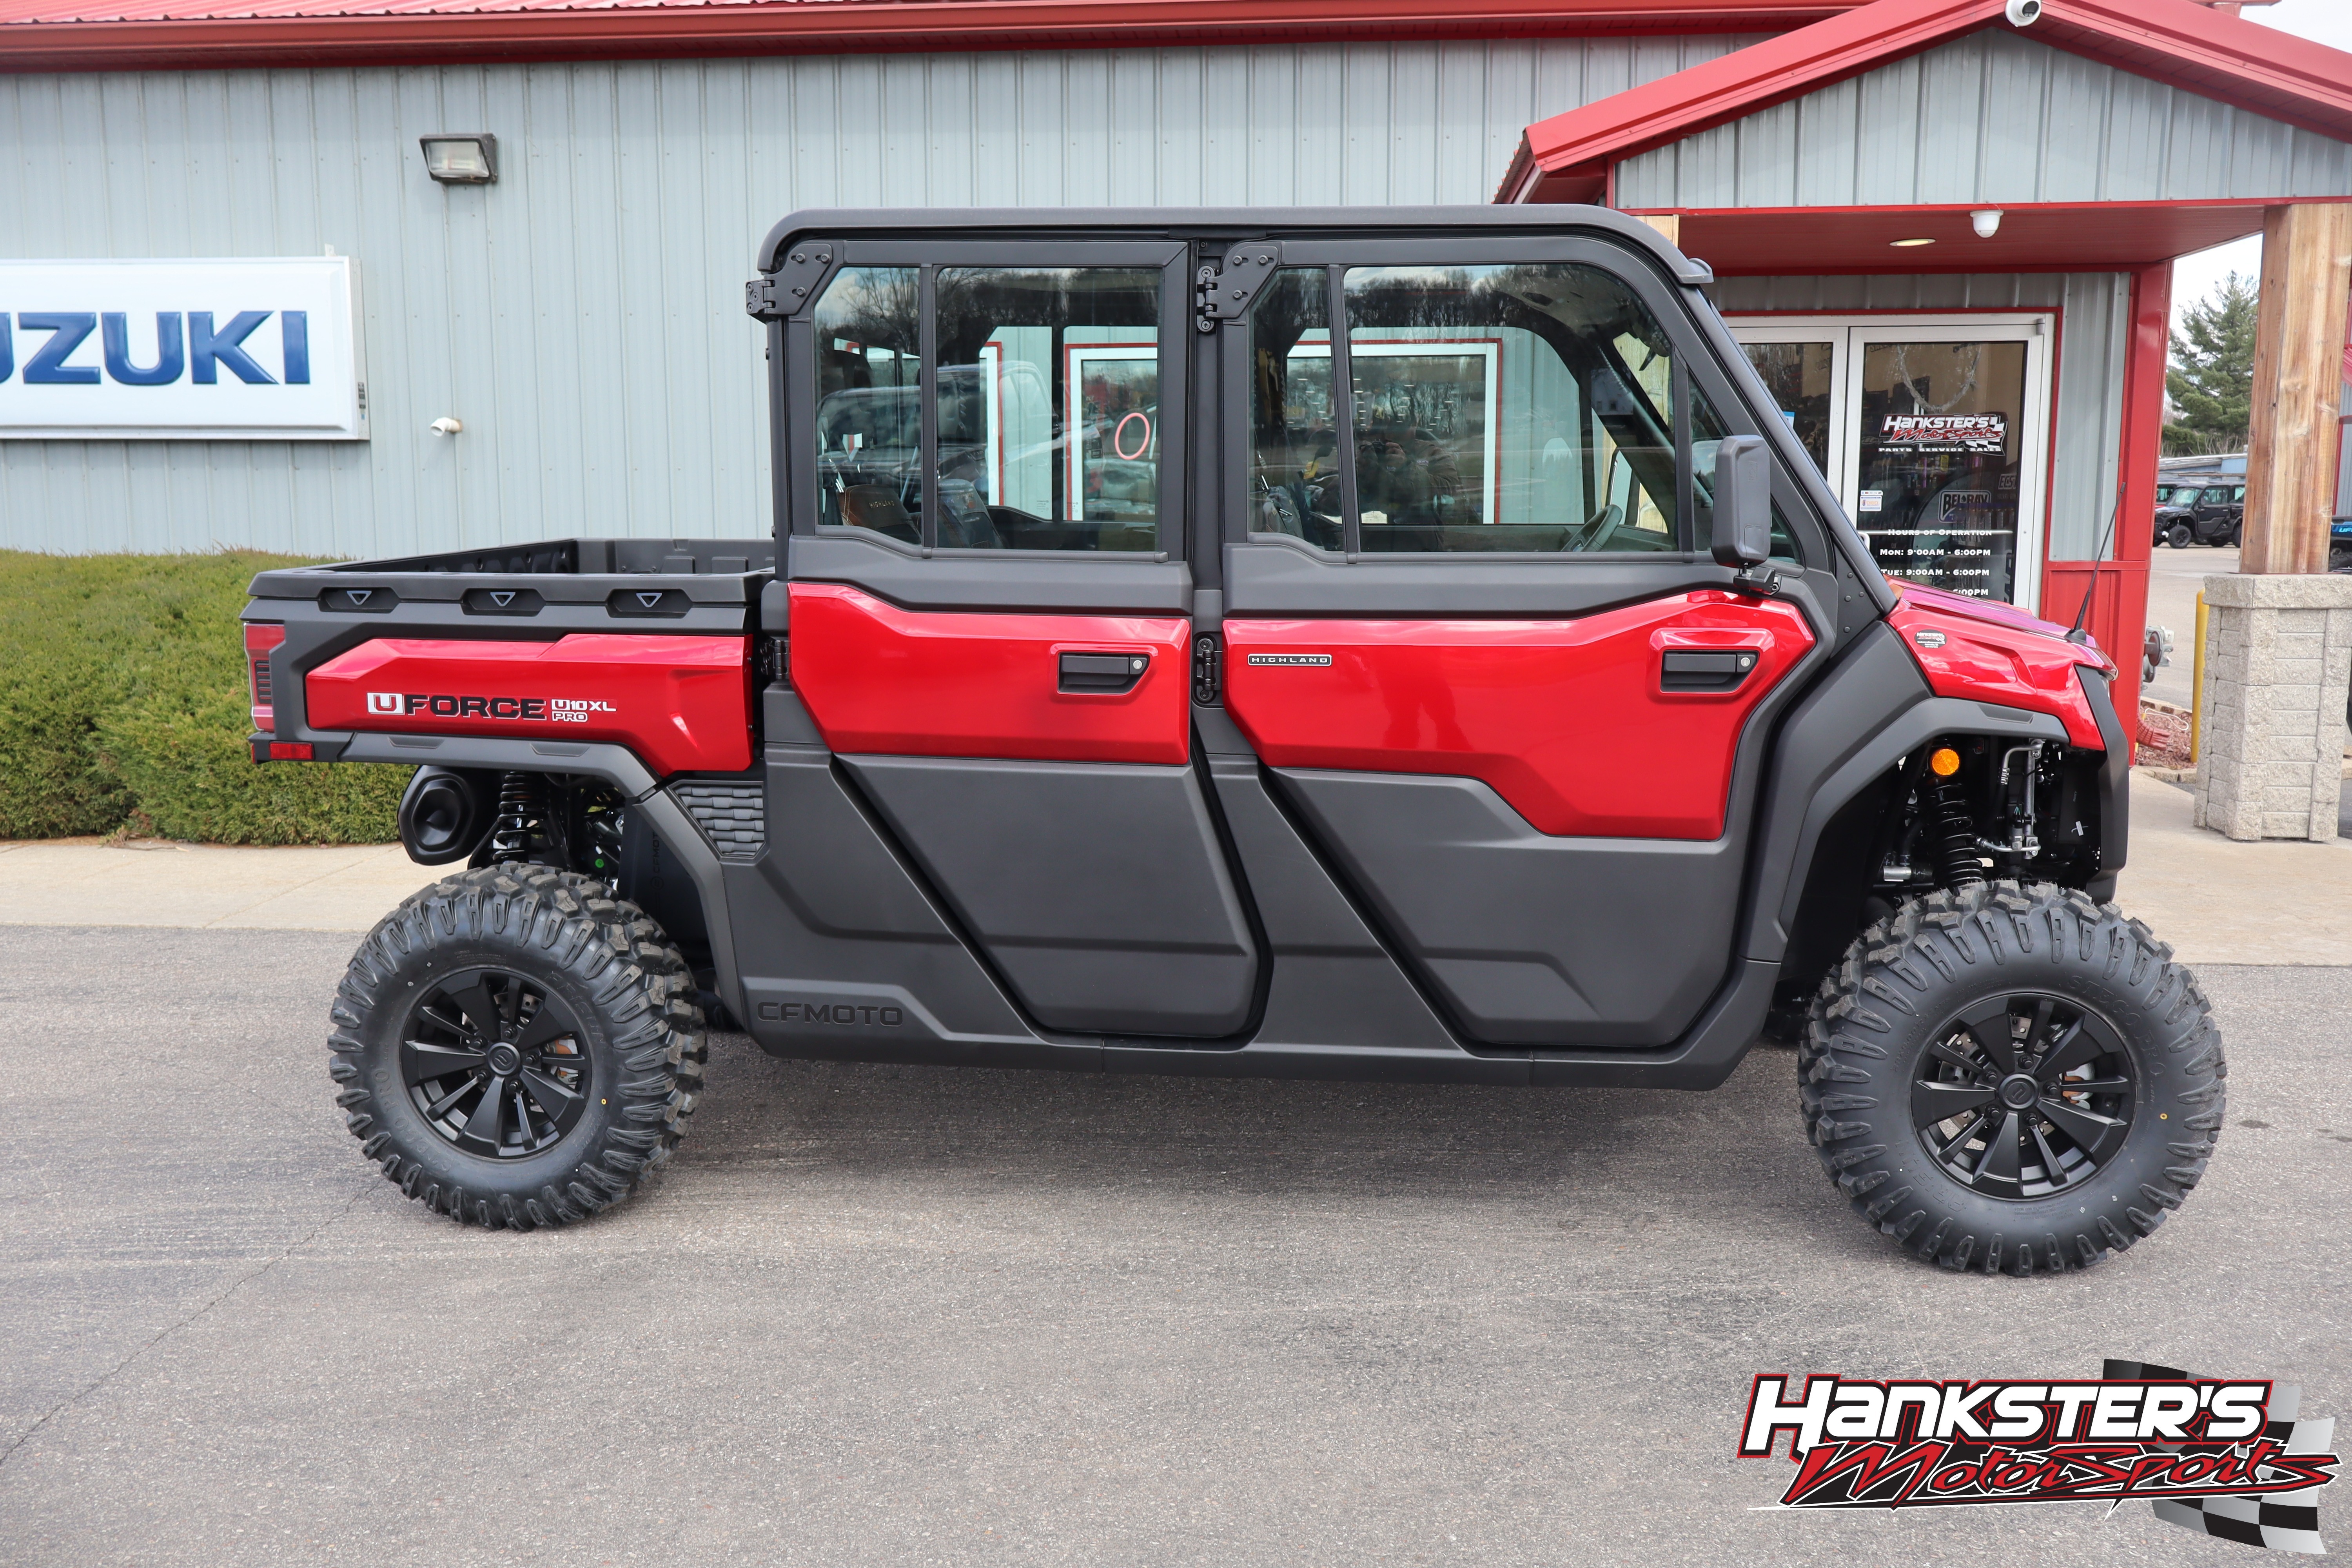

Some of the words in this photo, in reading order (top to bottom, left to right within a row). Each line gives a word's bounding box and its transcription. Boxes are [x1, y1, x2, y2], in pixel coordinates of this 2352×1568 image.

[0, 311, 310, 385] ZUKI
[869, 500, 895, 508] HIGHLAND
[552, 711, 588, 722] PRO
[757, 1002, 903, 1027] CFMOTO
[374, 1068, 400, 1114] PRO
[394, 1116, 453, 1173] STEGO
